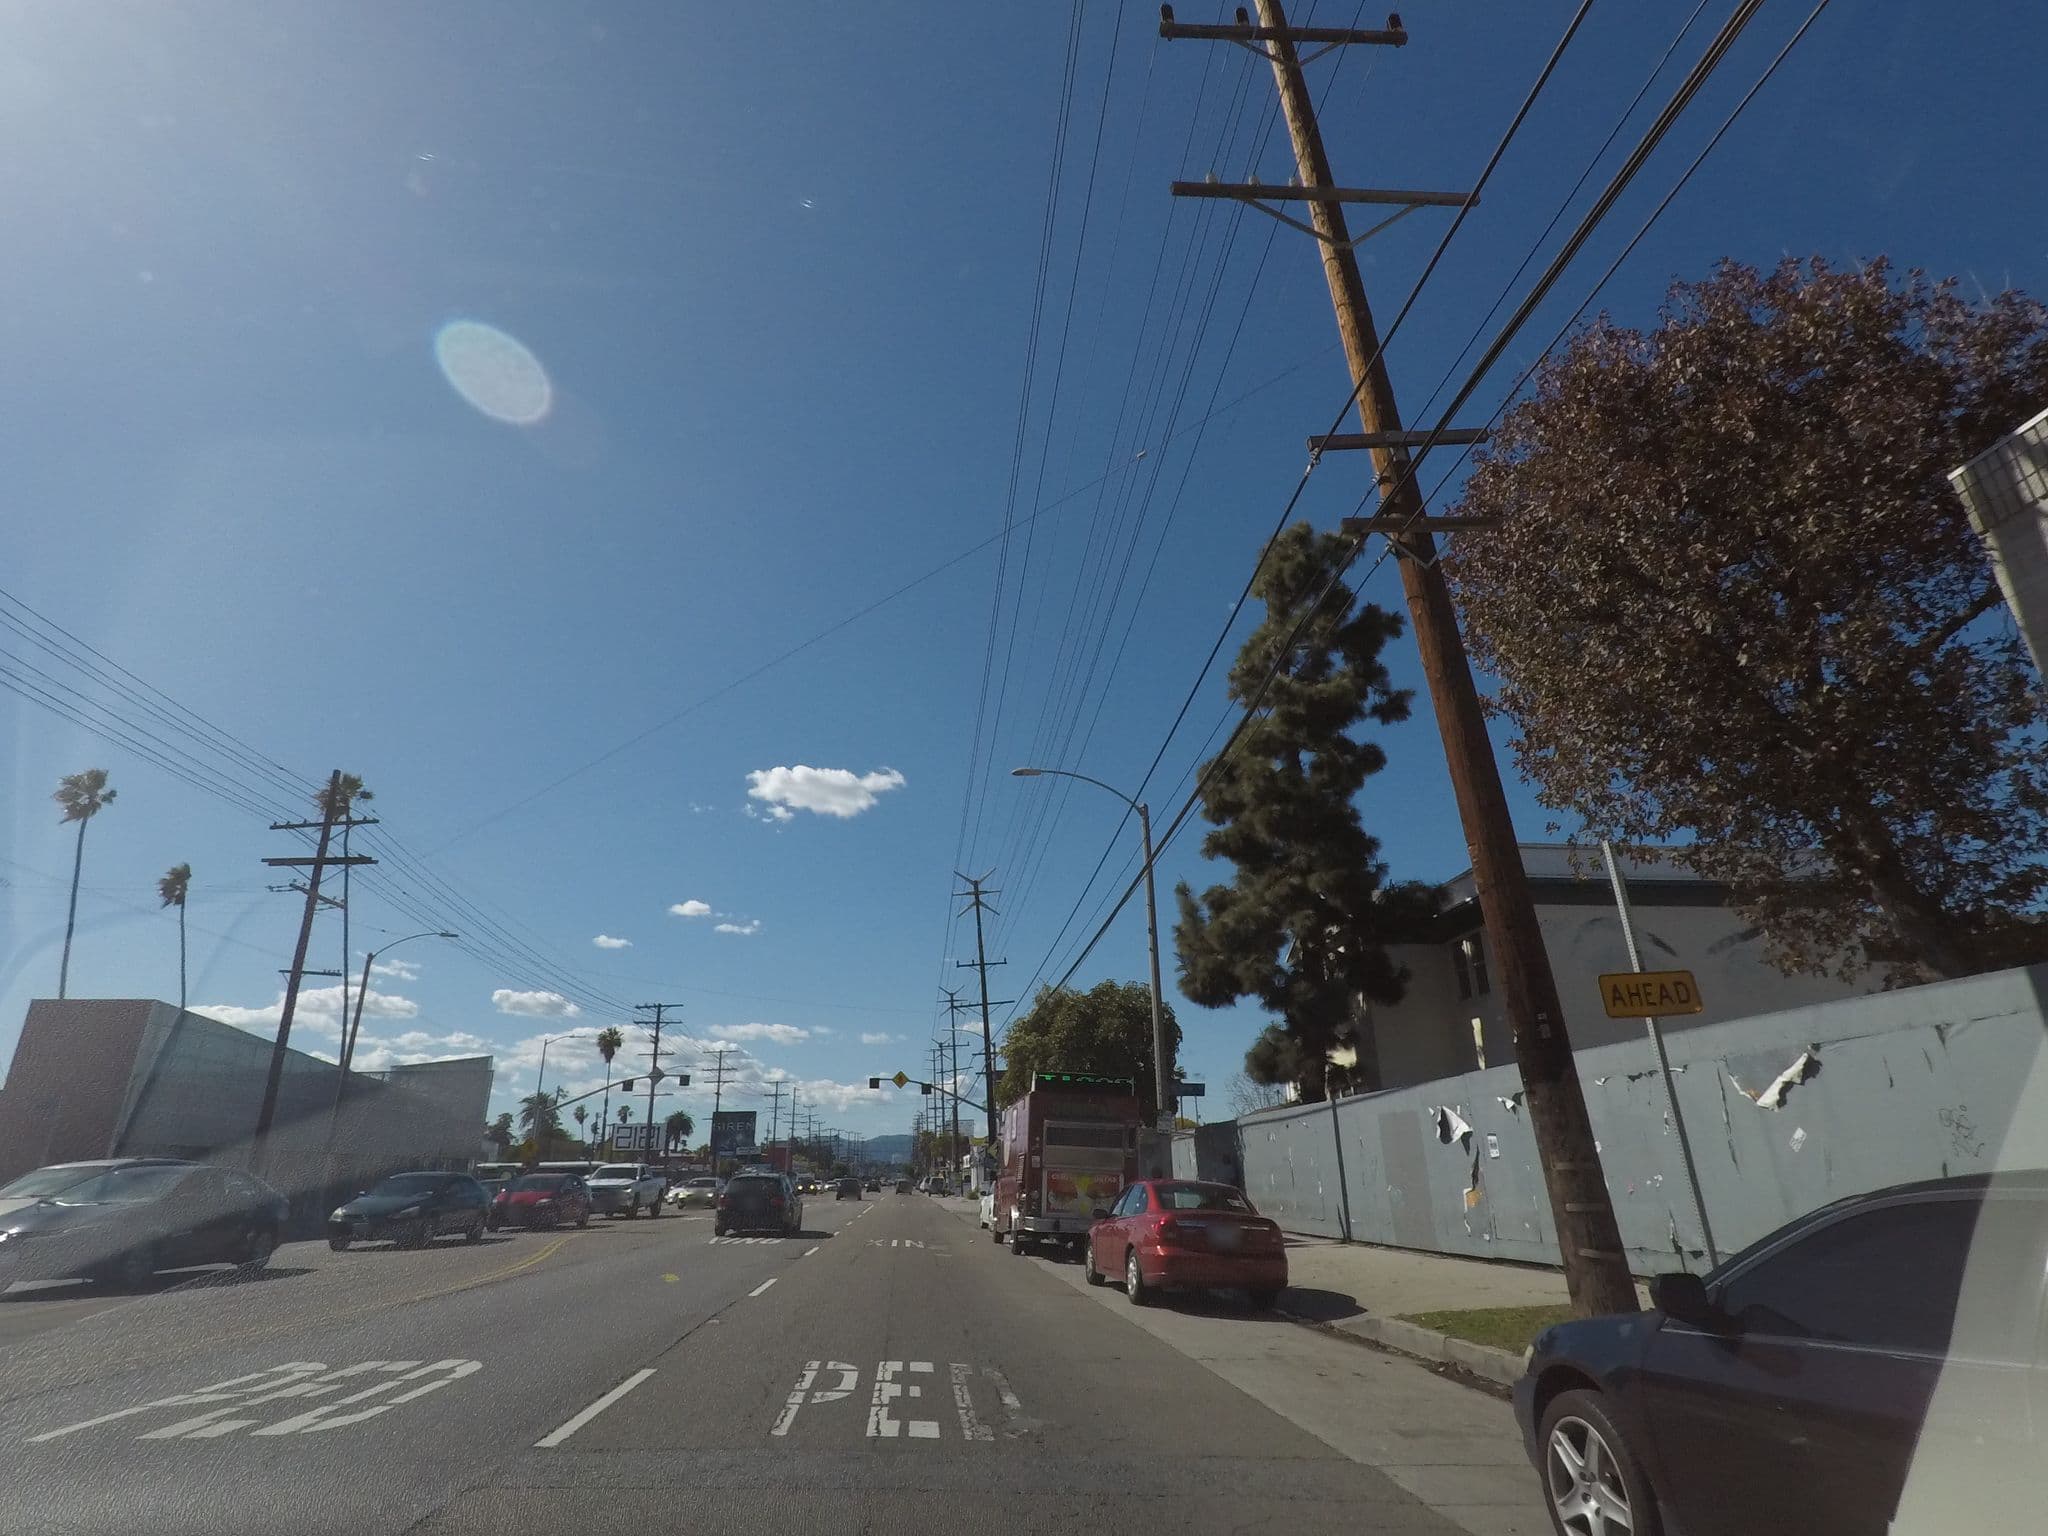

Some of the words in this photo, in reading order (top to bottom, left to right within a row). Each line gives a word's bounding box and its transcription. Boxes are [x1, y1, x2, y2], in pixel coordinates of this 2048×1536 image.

[1611, 981, 1691, 1008] AHEAD
[23, 1359, 483, 1442] PED
[768, 1360, 1029, 1441] PED
